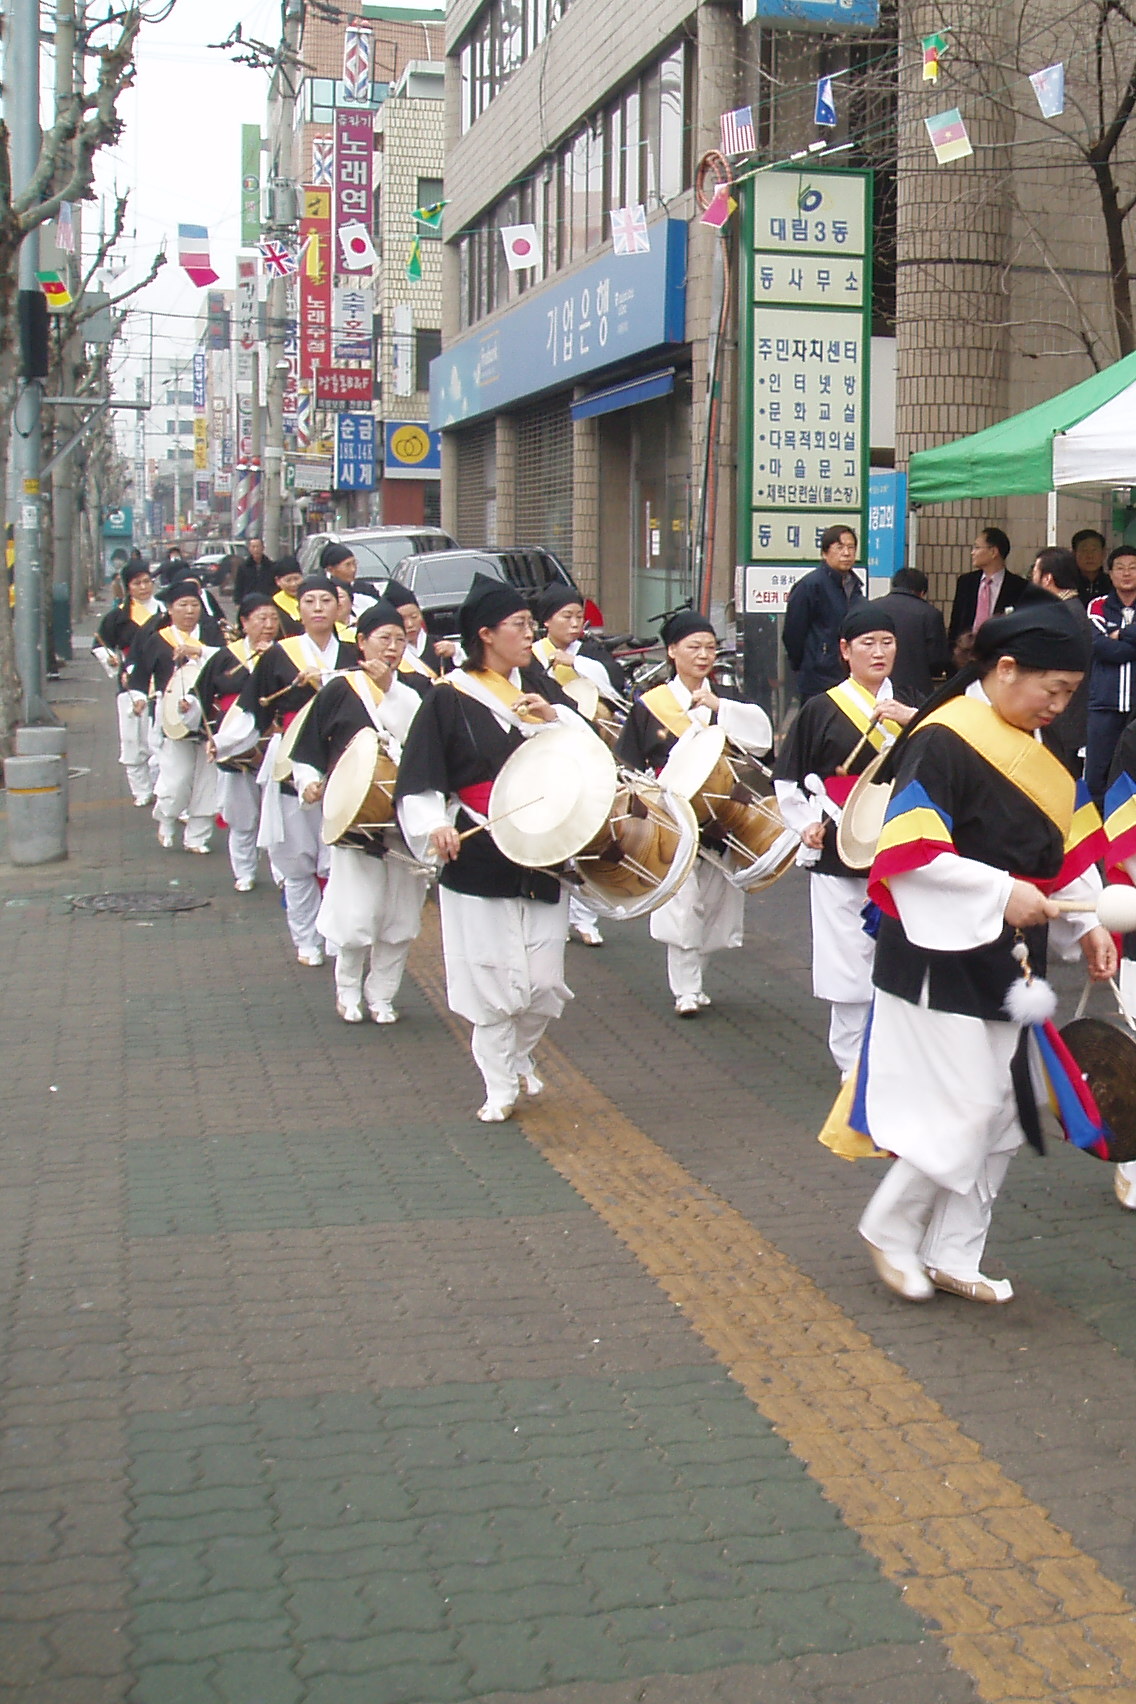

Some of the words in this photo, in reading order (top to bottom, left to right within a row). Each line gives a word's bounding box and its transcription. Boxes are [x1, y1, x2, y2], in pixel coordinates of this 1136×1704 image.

[769, 217, 849, 244] 대림3동
[759, 266, 859, 292] 동사무소
[546, 277, 610, 366] 기업은행
[758, 337, 857, 364] 주민자치센터
[769, 373, 856, 395] 인터넷방
[769, 402, 856, 423] 문화교실
[340, 418, 373, 440] 순금
[769, 430, 856, 451] 다목적회의실
[340, 463, 373, 486] 시계
[769, 458, 856, 479] 마을문고
